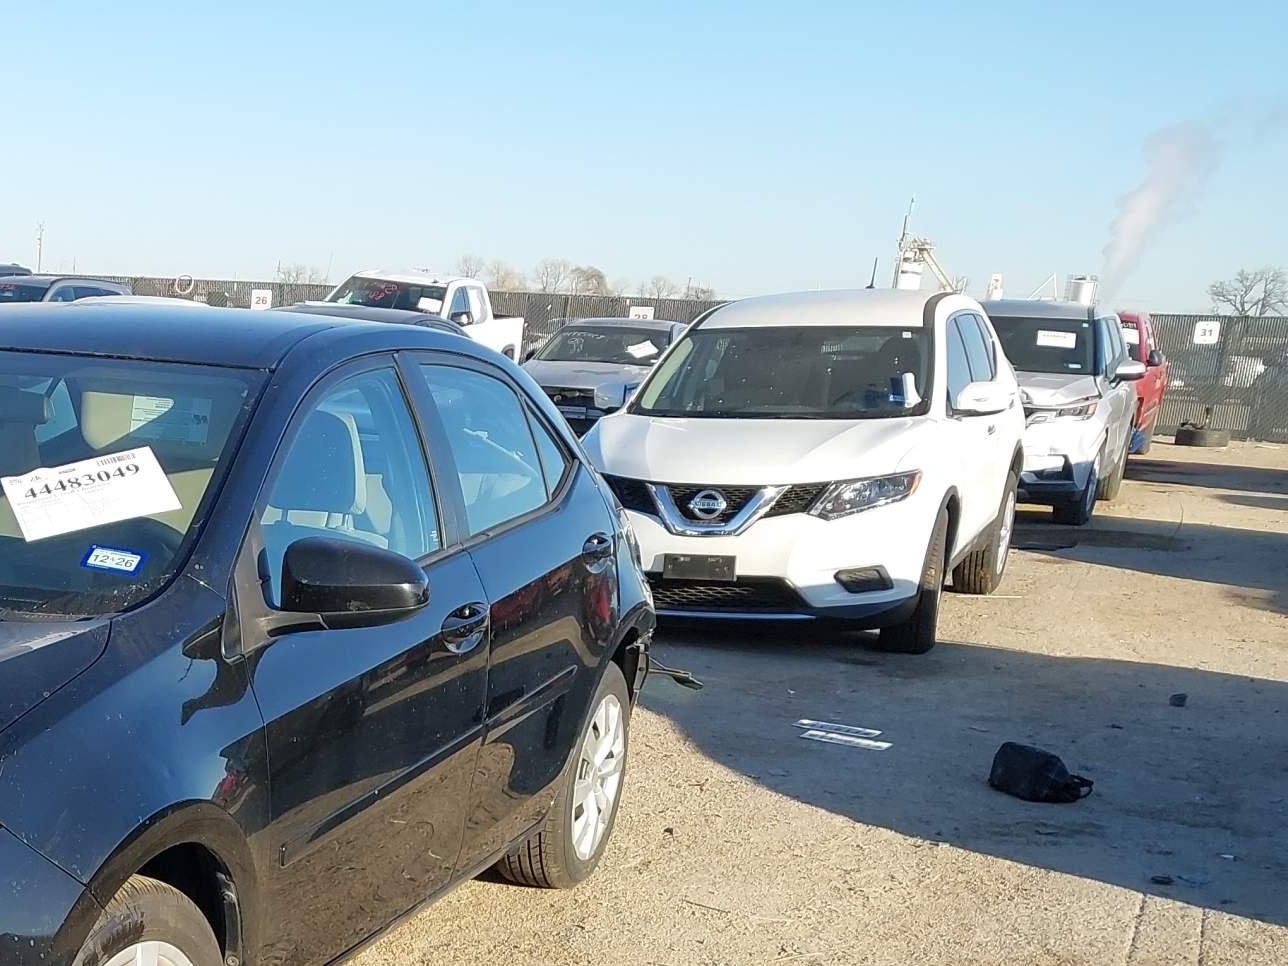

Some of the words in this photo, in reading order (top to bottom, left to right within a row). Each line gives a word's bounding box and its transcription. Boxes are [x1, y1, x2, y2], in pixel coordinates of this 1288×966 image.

[255, 296, 268, 305] 26
[1200, 328, 1213, 337] 31
[24, 463, 140, 500] 44483049
